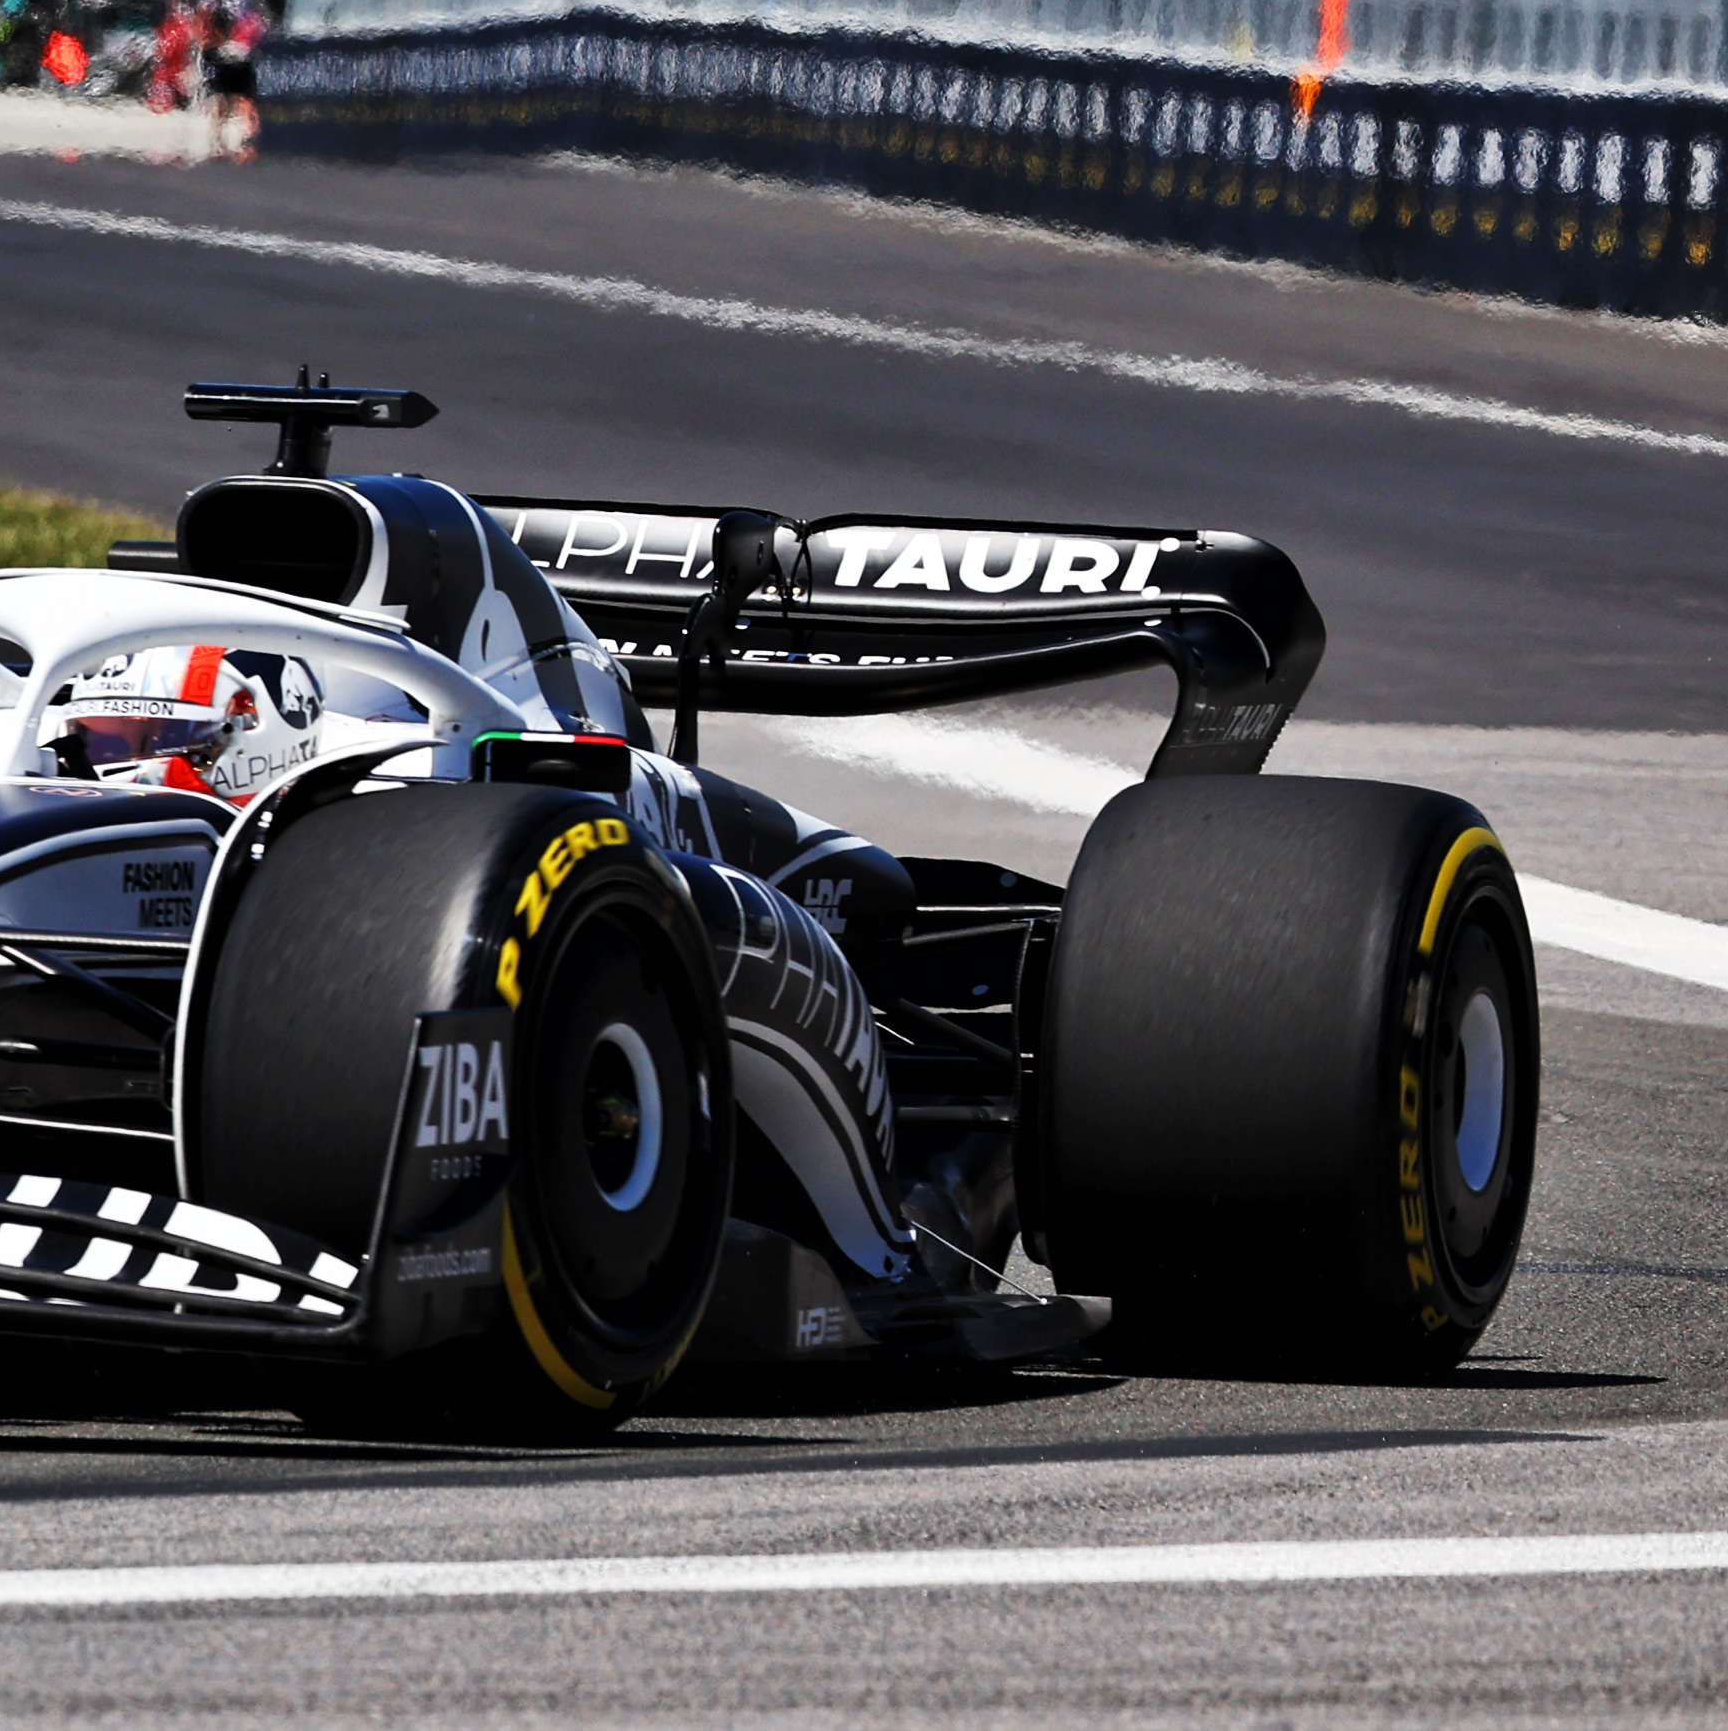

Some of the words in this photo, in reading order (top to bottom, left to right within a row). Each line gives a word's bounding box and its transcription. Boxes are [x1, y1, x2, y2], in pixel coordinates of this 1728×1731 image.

[511, 514, 715, 580] LPH
[829, 536, 1163, 595] TAURI
[123, 862, 194, 894] FASHION
[139, 897, 192, 928] MEETS
[496, 935, 524, 1012] P
[514, 817, 631, 940] ZERO
[415, 1039, 510, 1147] ZIBA
[1399, 1064, 1435, 1292] ZERO
